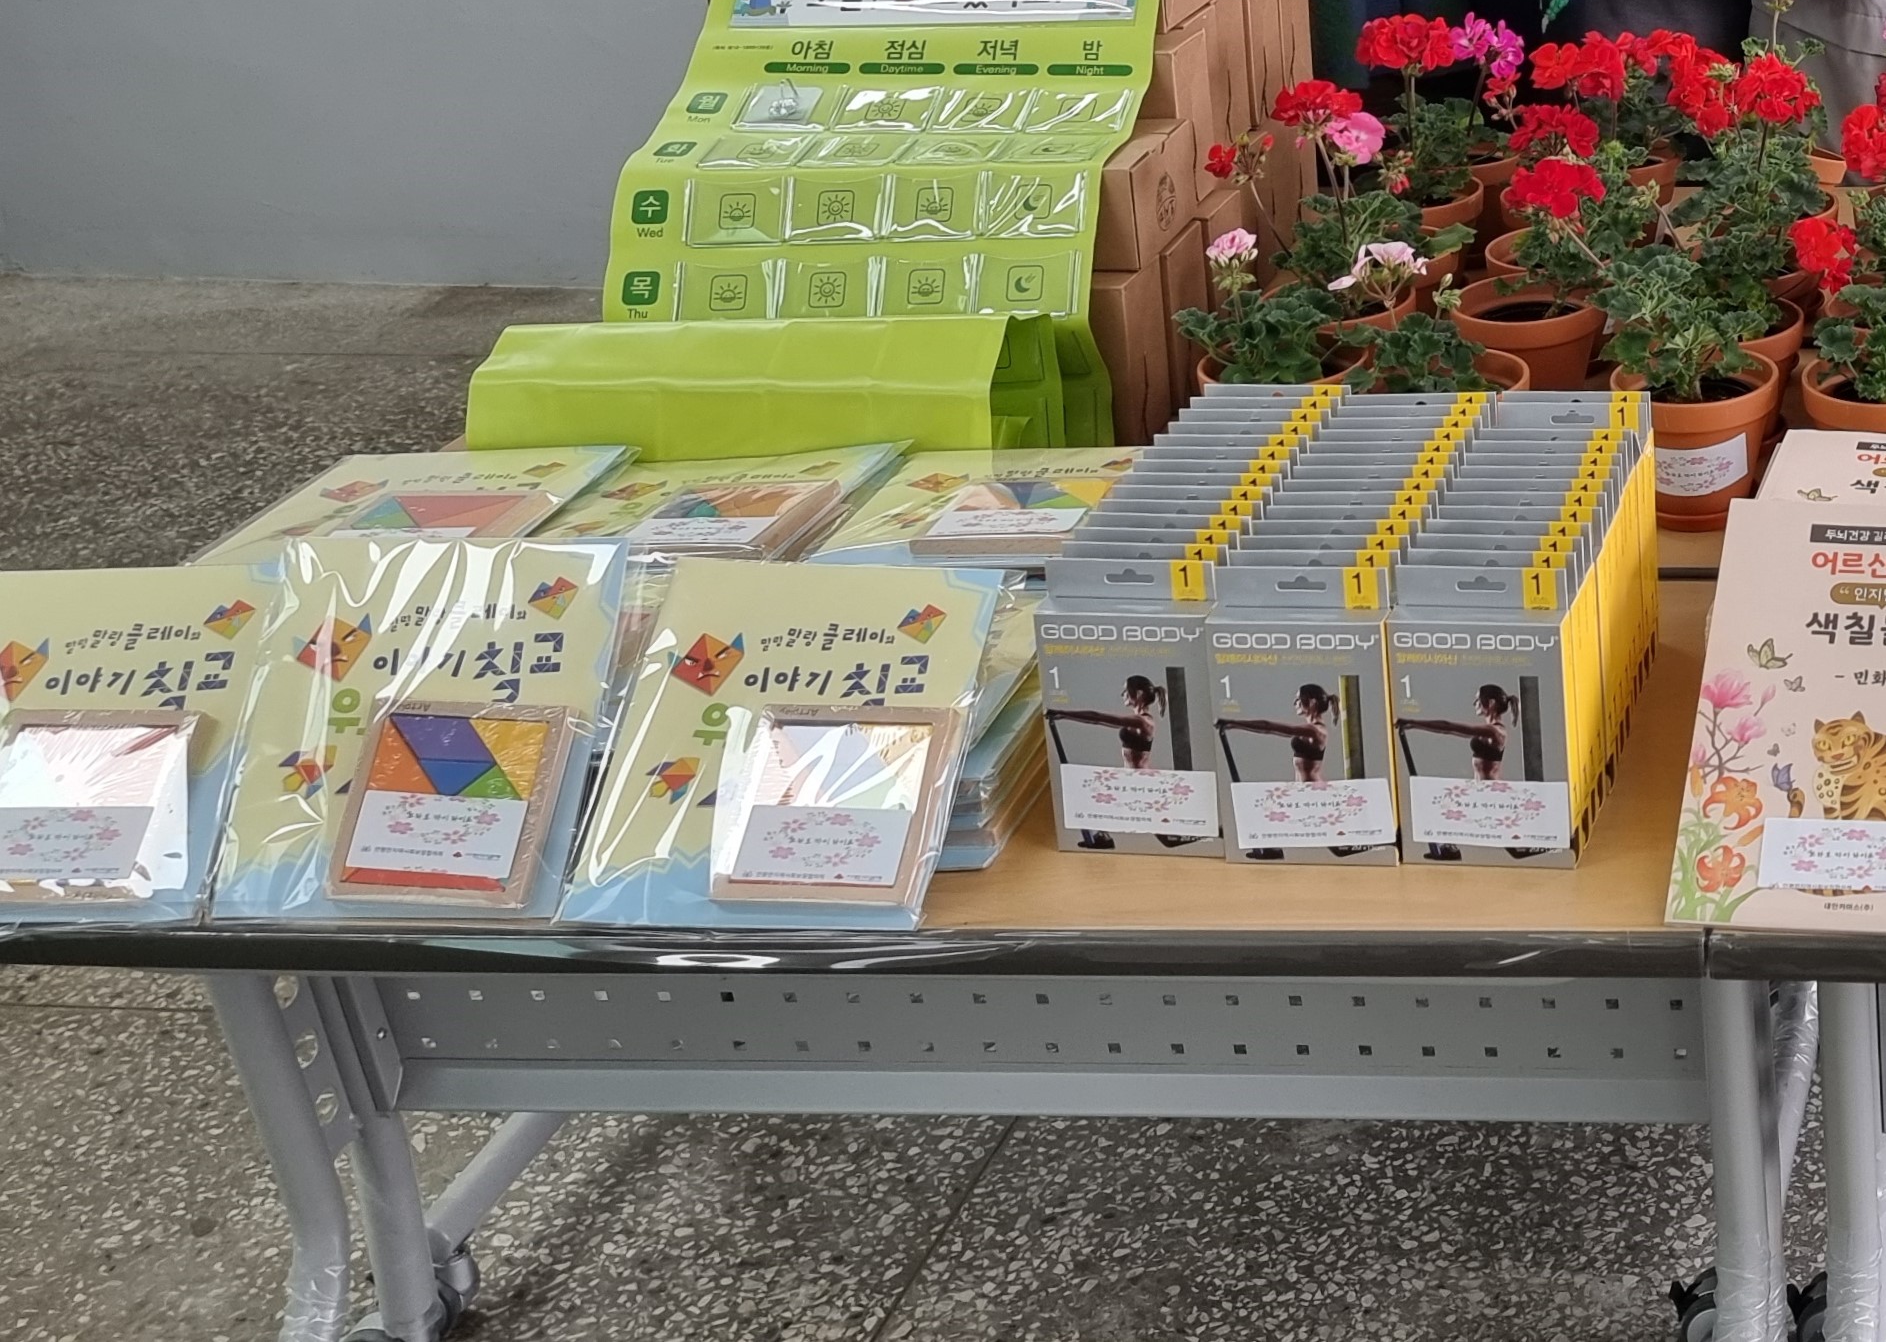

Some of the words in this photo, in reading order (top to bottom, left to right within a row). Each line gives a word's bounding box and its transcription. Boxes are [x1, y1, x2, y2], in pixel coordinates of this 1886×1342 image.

[790, 40, 834, 60] 아침
[884, 40, 928, 60] 점심
[976, 39, 1020, 60] 저녁
[1081, 40, 1103, 60] 밤
[786, 63, 830, 74] Morning
[880, 63, 924, 75] Daytime
[975, 64, 1018, 76] Evening
[1075, 65, 1105, 77] Night
[698, 94, 720, 110] 월
[639, 195, 661, 219] 수
[636, 227, 664, 238] Wed
[630, 276, 653, 299] 목
[627, 308, 649, 319] Thu
[1617, 406, 1626, 426] 1
[1825, 528, 1871, 542] 두뇌건강
[1178, 565, 1189, 588] 1
[1352, 572, 1362, 595] 1
[1531, 572, 1541, 595] 1
[820, 622, 897, 651] 클레이와
[1040, 624, 1118, 641] GOOD
[1123, 626, 1201, 643] BODY
[1213, 632, 1291, 649] GOOD
[1297, 634, 1375, 650] BODY
[1394, 632, 1471, 649] GOOD
[1477, 634, 1555, 651] BODY
[473, 632, 565, 704] 칠교
[1049, 666, 1060, 689] 1
[45, 667, 138, 695] 이야기
[743, 666, 834, 696] 이야기
[1220, 675, 1231, 699] 1
[1400, 674, 1411, 698] 1
